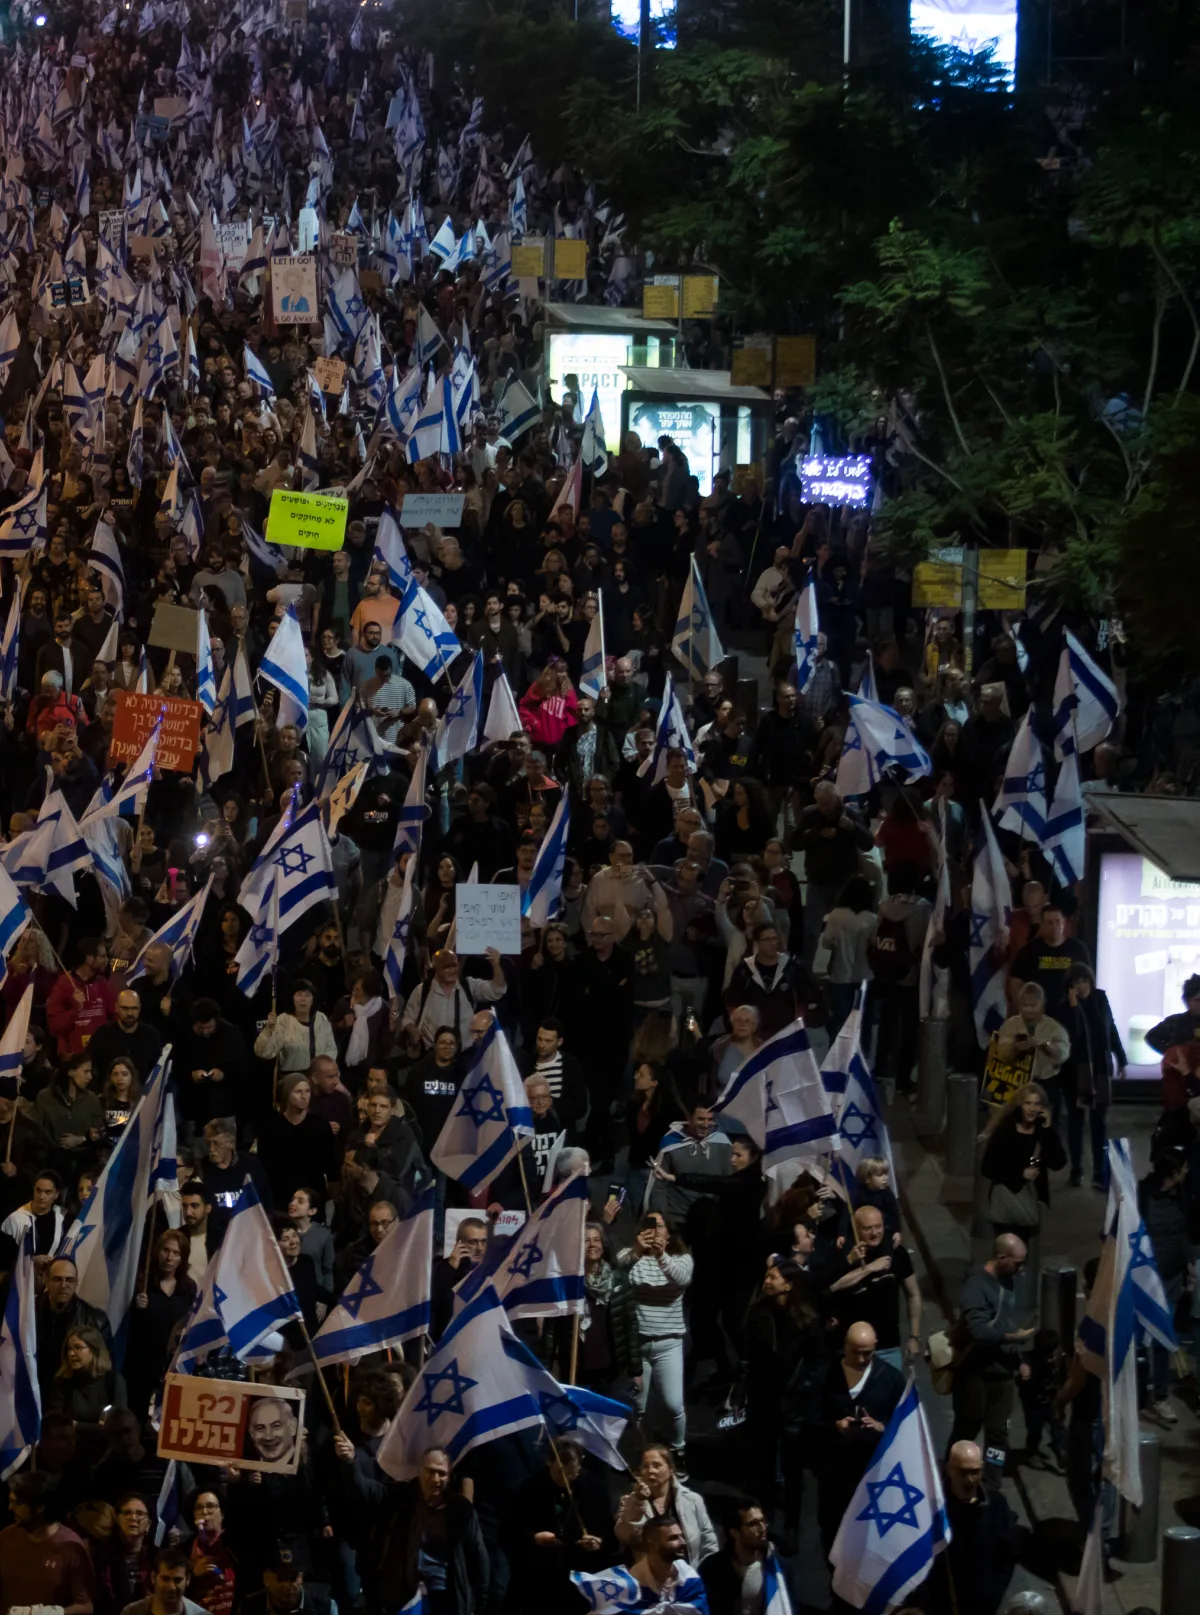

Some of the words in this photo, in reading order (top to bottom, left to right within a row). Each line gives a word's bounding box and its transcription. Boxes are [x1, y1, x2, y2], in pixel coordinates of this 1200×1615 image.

[274, 257, 287, 265] LET
[561, 374, 620, 389] IPACT
[281, 495, 310, 505] ופושעים
[290, 512, 322, 524] מחוקקים
[125, 695, 138, 708] לא
[132, 713, 144, 731] בך
[197, 1393, 236, 1419] רק
[169, 1417, 237, 1451] בגללו
